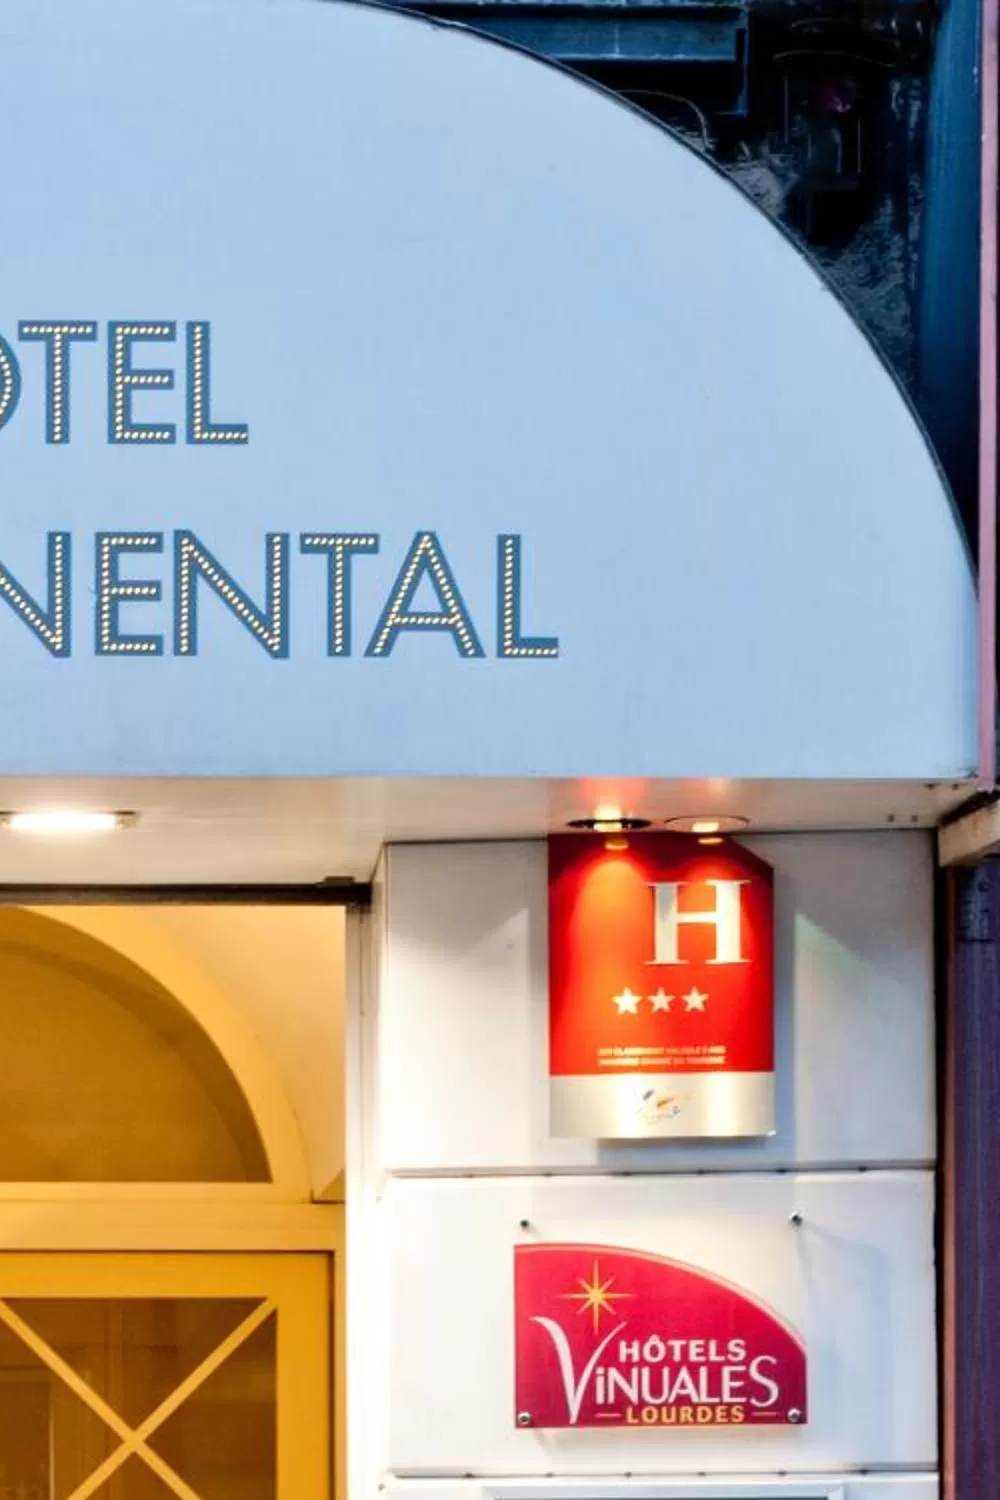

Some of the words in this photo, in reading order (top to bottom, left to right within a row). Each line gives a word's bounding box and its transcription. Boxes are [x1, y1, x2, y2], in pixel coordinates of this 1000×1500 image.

[641, 879, 752, 965] H
[618, 1334, 747, 1363] HÔTELS
[625, 1406, 744, 1424] LOURDES
